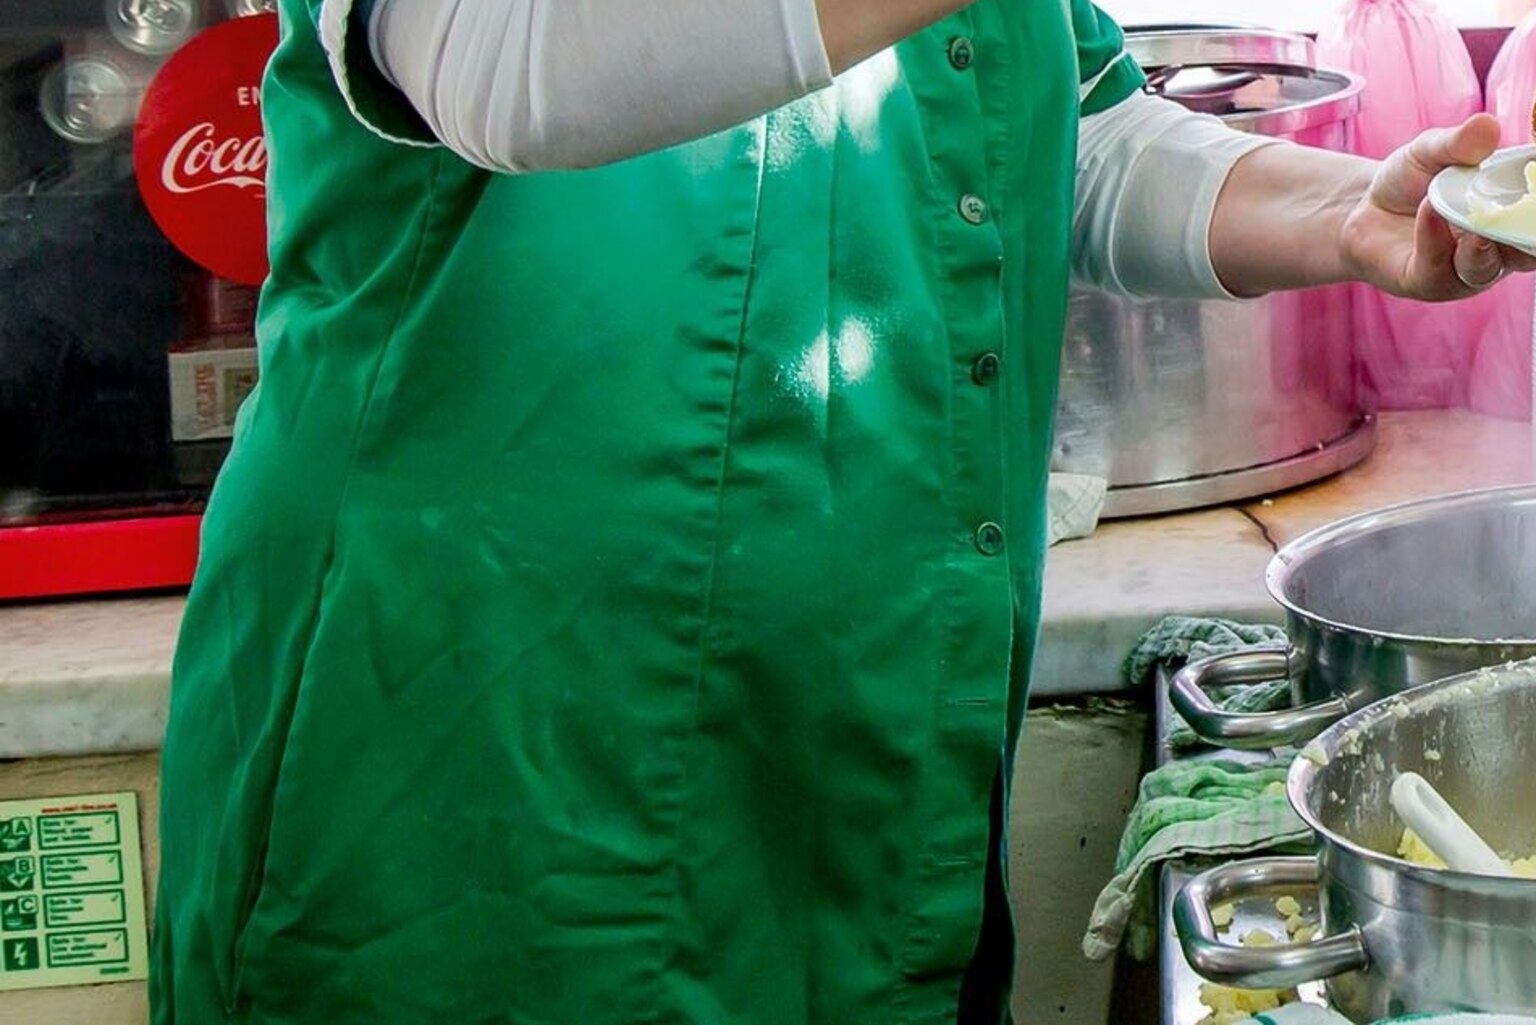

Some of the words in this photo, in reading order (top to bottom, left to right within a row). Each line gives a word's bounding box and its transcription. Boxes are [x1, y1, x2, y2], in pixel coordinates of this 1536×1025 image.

[15, 820, 27, 834] A
[18, 859, 30, 872] B
[21, 898, 34, 912] C
